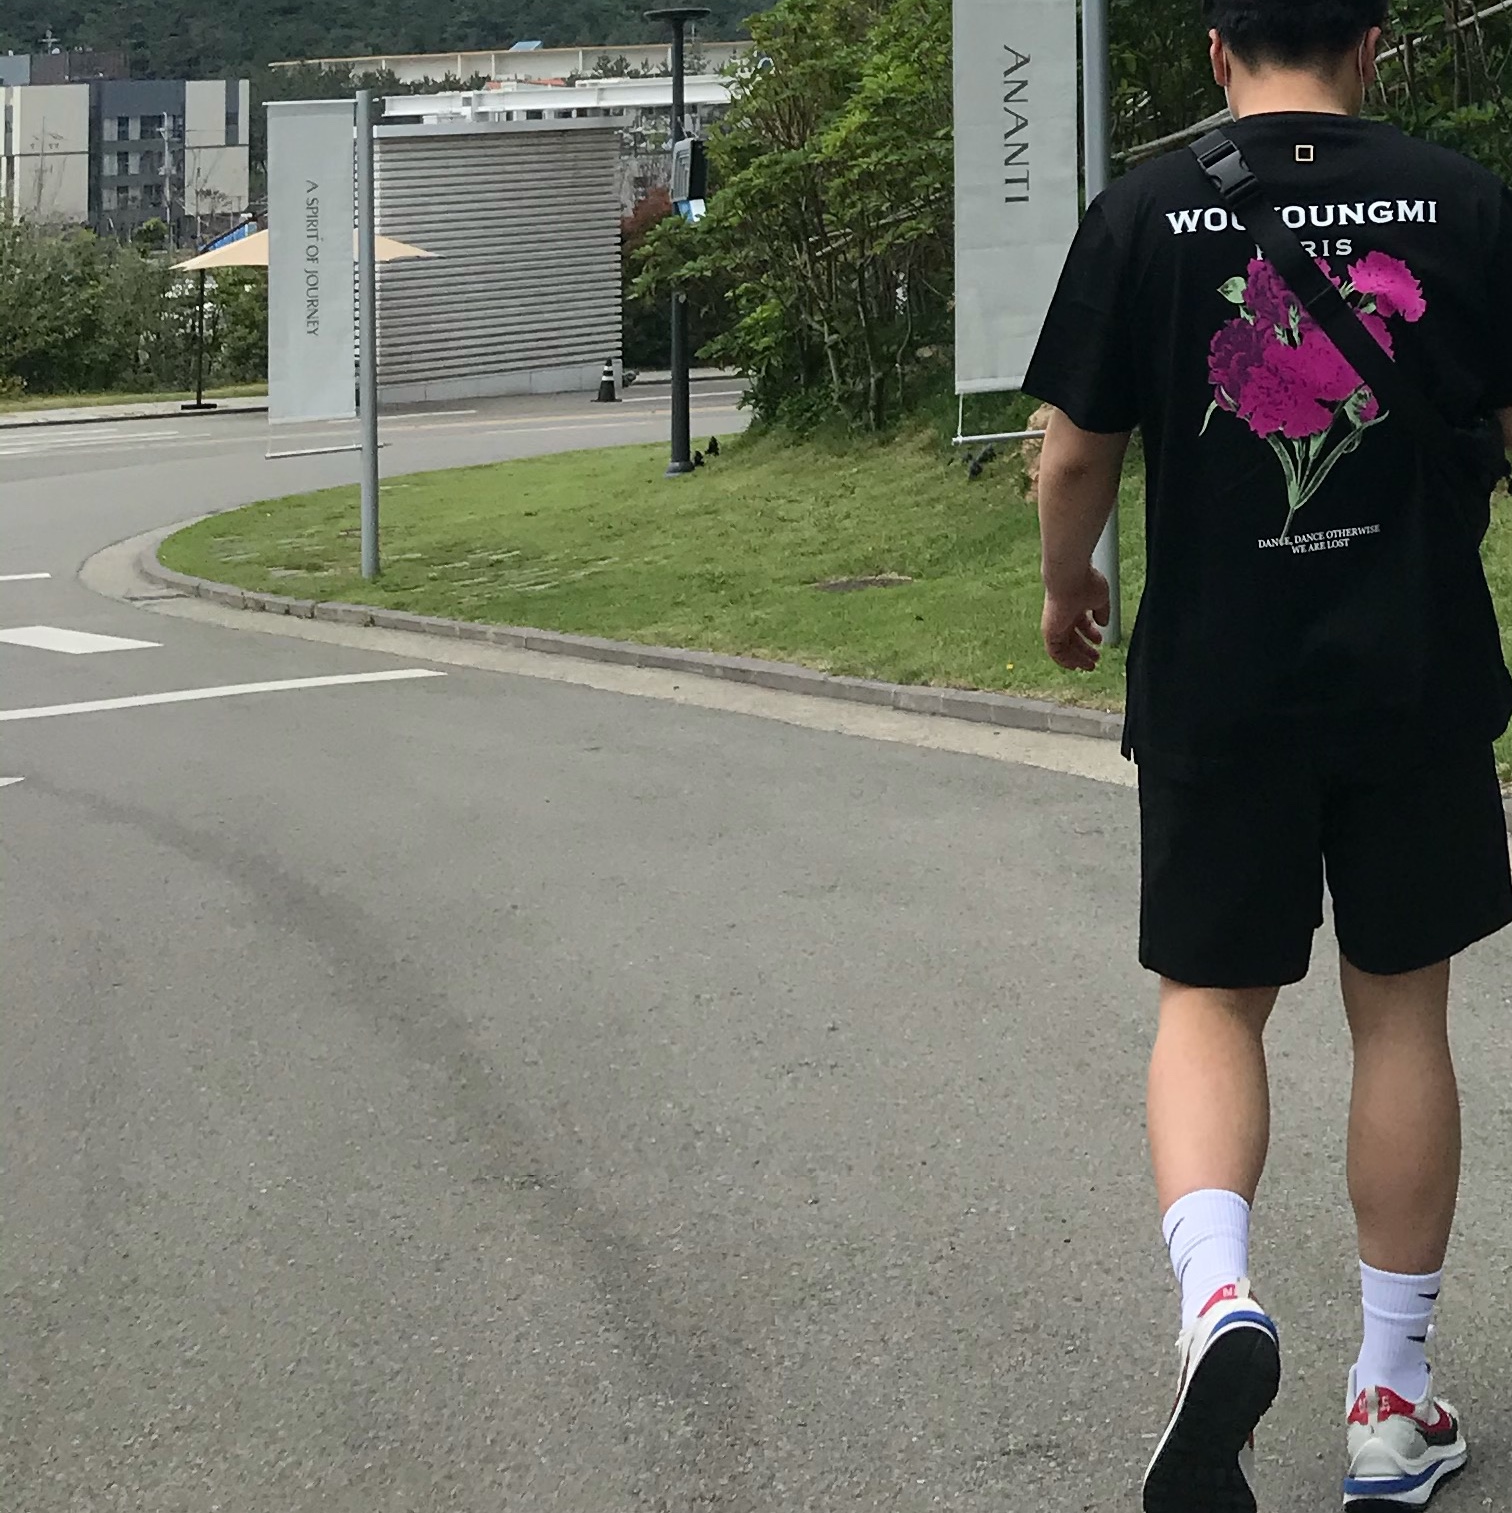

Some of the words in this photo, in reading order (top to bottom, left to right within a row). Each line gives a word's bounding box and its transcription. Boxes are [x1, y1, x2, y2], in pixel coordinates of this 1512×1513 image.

[1003, 44, 1031, 204] ANANTI
[305, 179, 320, 194] A
[305, 197, 320, 242] SPIRIT
[1165, 199, 1438, 235] WOOUNGMI
[305, 244, 320, 264] OF
[1255, 239, 1353, 261] RIS
[304, 268, 320, 337] JOURNEY
[1294, 531, 1325, 544] DANCE
[1326, 524, 1381, 539] OTHERWISE
[1291, 544, 1307, 554] WE
[1308, 541, 1326, 552] ARE
[1327, 538, 1350, 549] LOST
